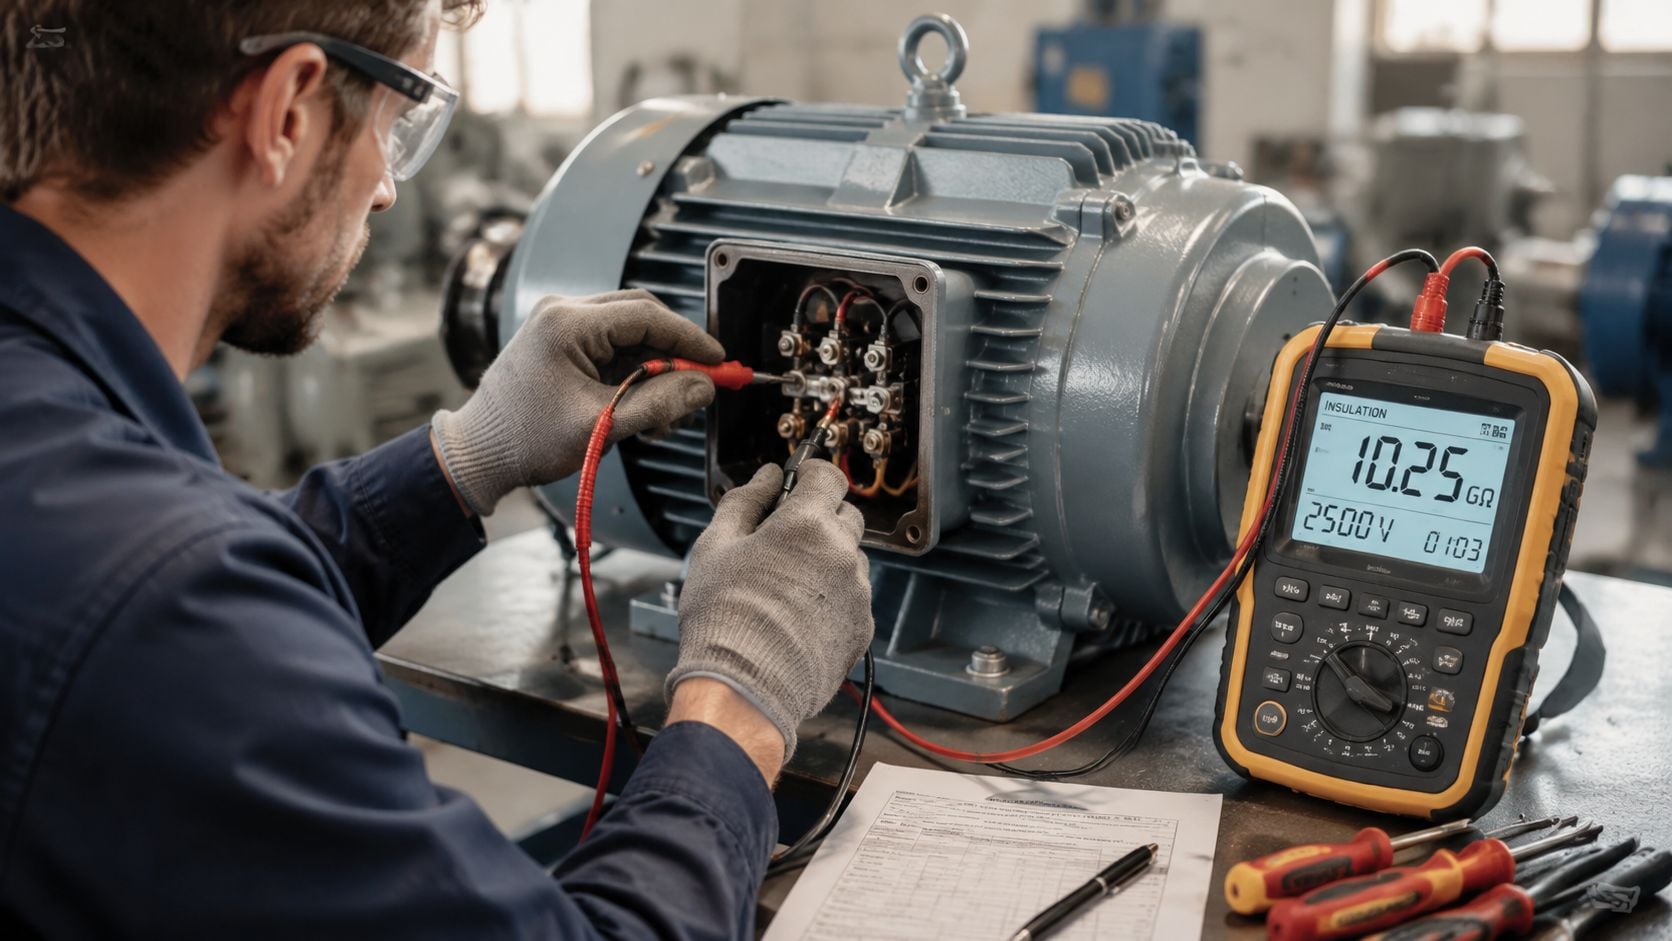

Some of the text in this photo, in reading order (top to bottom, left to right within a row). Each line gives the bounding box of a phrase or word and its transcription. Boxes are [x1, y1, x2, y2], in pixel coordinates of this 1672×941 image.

[1324, 400, 1388, 419] INSULATION
[1352, 435, 1495, 508] 10.25 GΩ
